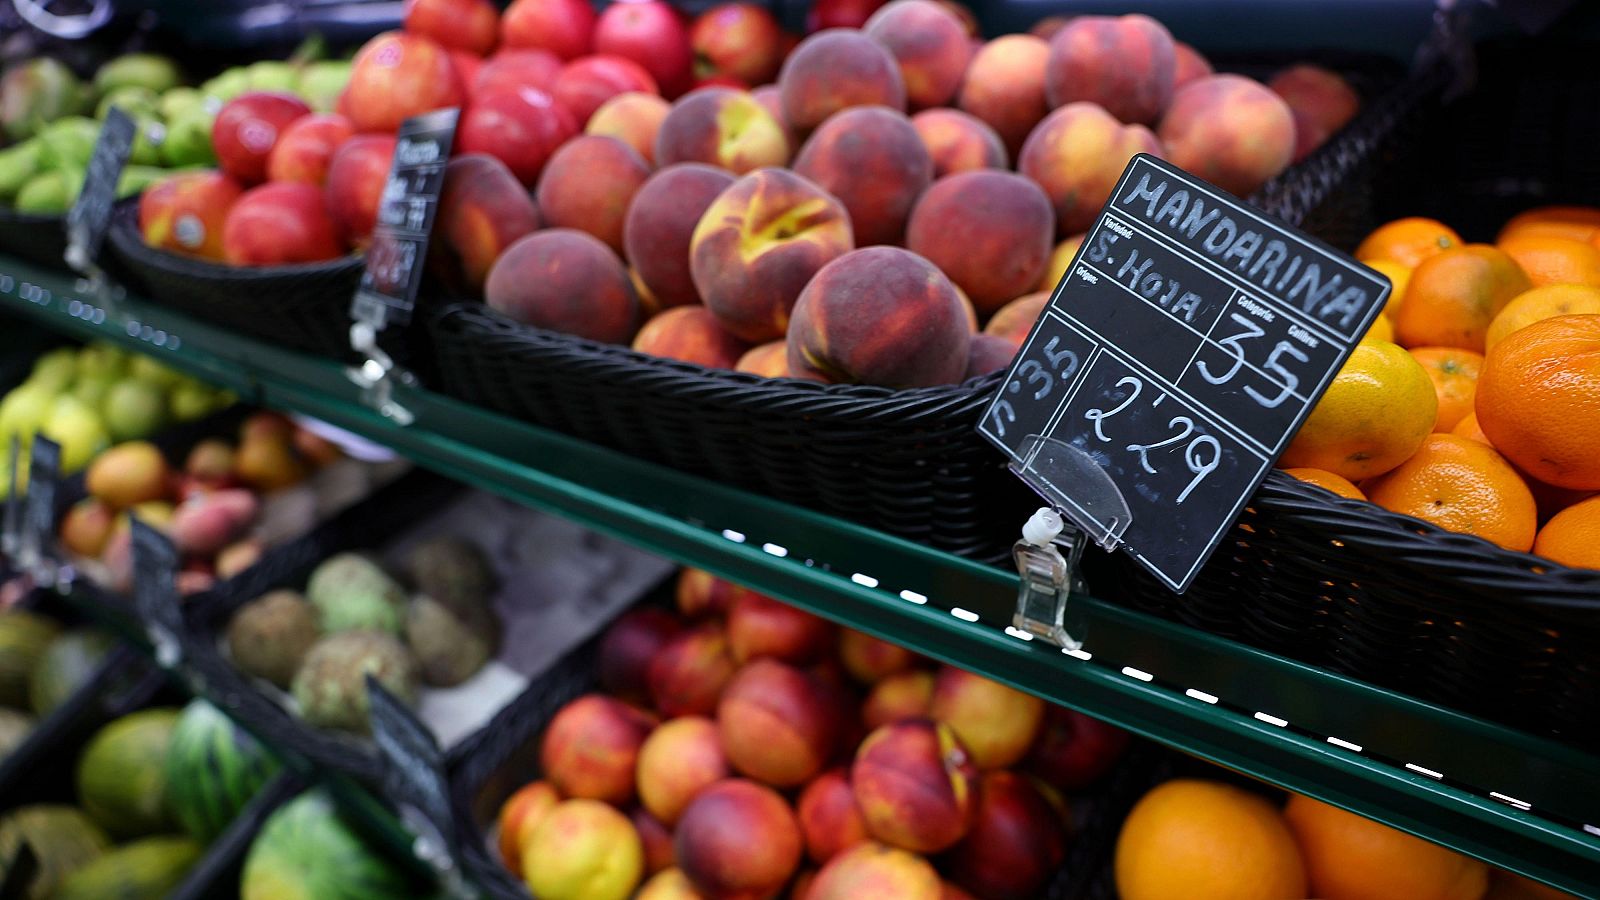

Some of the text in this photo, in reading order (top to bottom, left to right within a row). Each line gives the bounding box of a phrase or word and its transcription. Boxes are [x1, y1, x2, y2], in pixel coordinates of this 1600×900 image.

[1104, 217, 1133, 240] Variedad:
[1122, 172, 1367, 329] MANDARINA
[1076, 266, 1099, 285] Origen:
